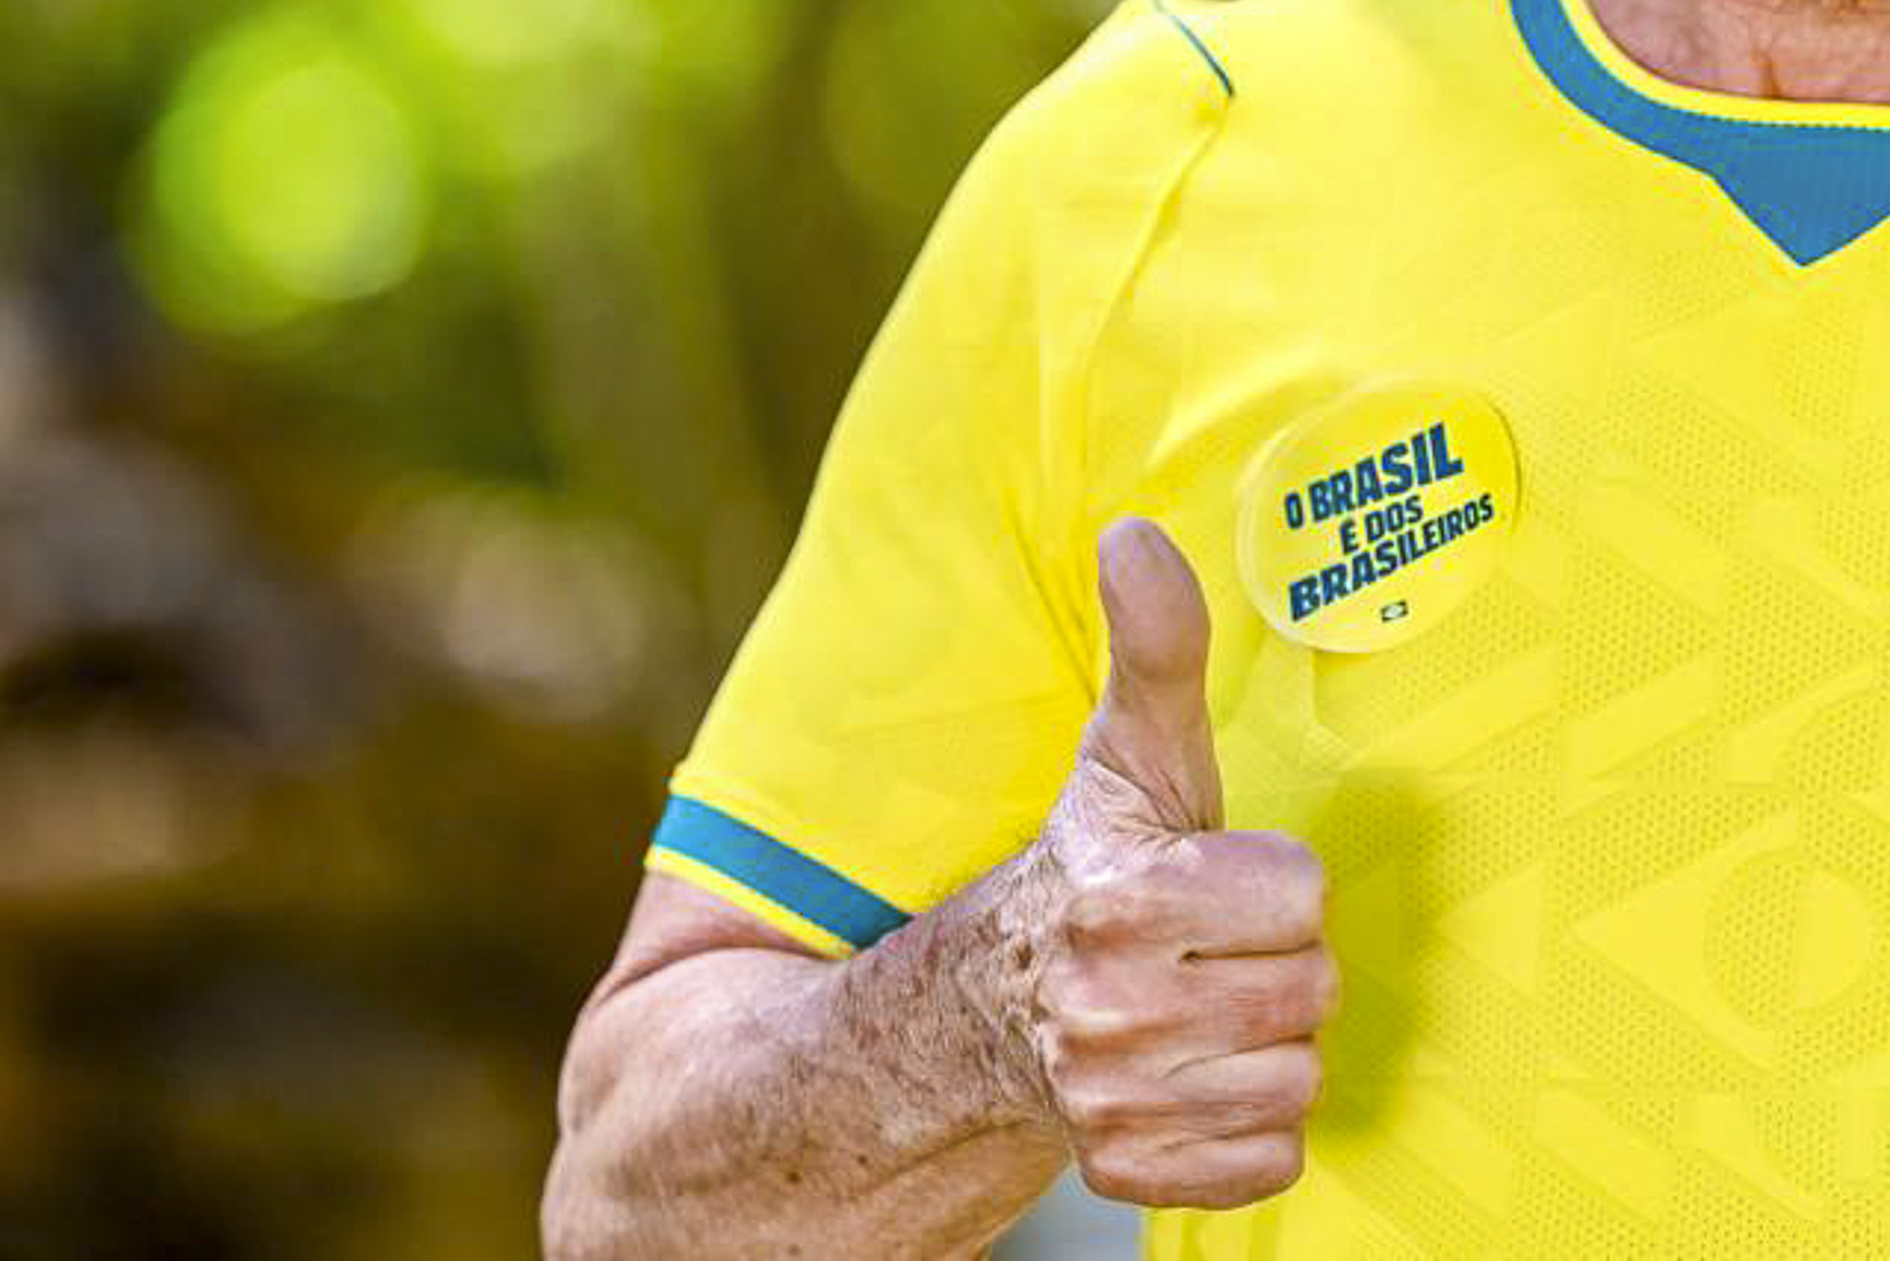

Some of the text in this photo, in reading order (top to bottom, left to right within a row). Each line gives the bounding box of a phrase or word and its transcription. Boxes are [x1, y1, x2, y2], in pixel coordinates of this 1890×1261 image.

[1285, 422, 1464, 530] O BRASIL
[1364, 494, 1424, 544] DOS
[1288, 494, 1495, 622] BRASILEIROS
